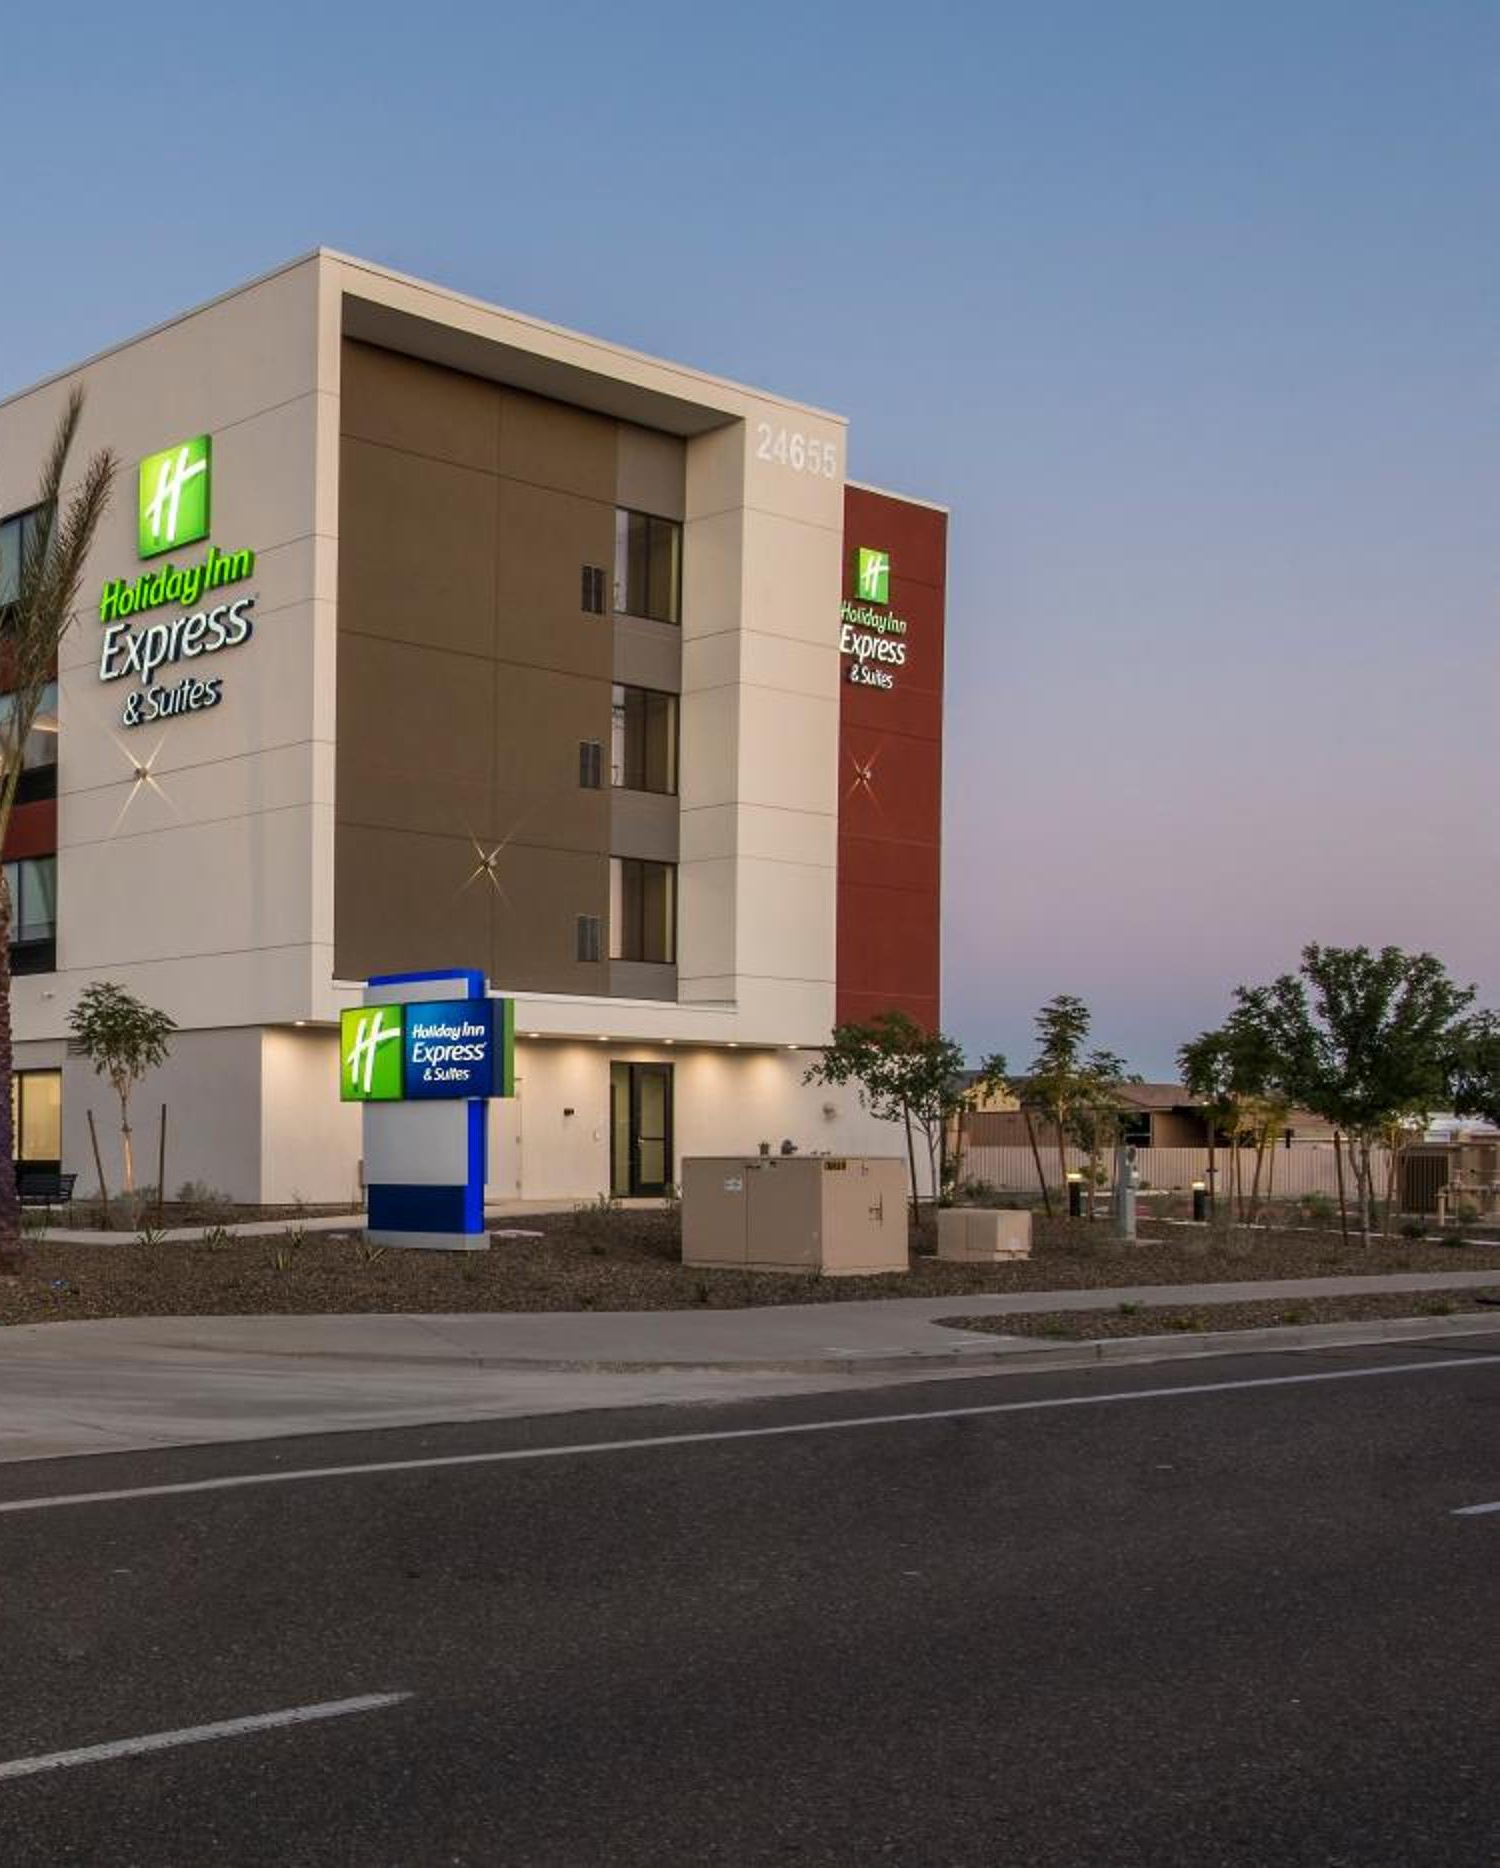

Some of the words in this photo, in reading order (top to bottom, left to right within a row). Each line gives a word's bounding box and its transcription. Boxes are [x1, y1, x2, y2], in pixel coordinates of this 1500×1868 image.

[757, 423, 837, 478] 24655
[100, 563, 202, 622] Holiday
[203, 546, 255, 590] Inn
[839, 600, 887, 634] Holiday
[887, 611, 906, 633] Inn
[100, 598, 254, 684] Express
[840, 623, 906, 665] Express
[851, 664, 860, 682] &
[860, 665, 893, 689] Suites
[123, 691, 141, 727] &
[145, 678, 223, 721] Suites
[412, 1024, 461, 1041] Holiday
[462, 1021, 485, 1036] Inn
[412, 1042, 486, 1067] Express
[423, 1068, 432, 1081] &
[434, 1067, 471, 1081] Suites
